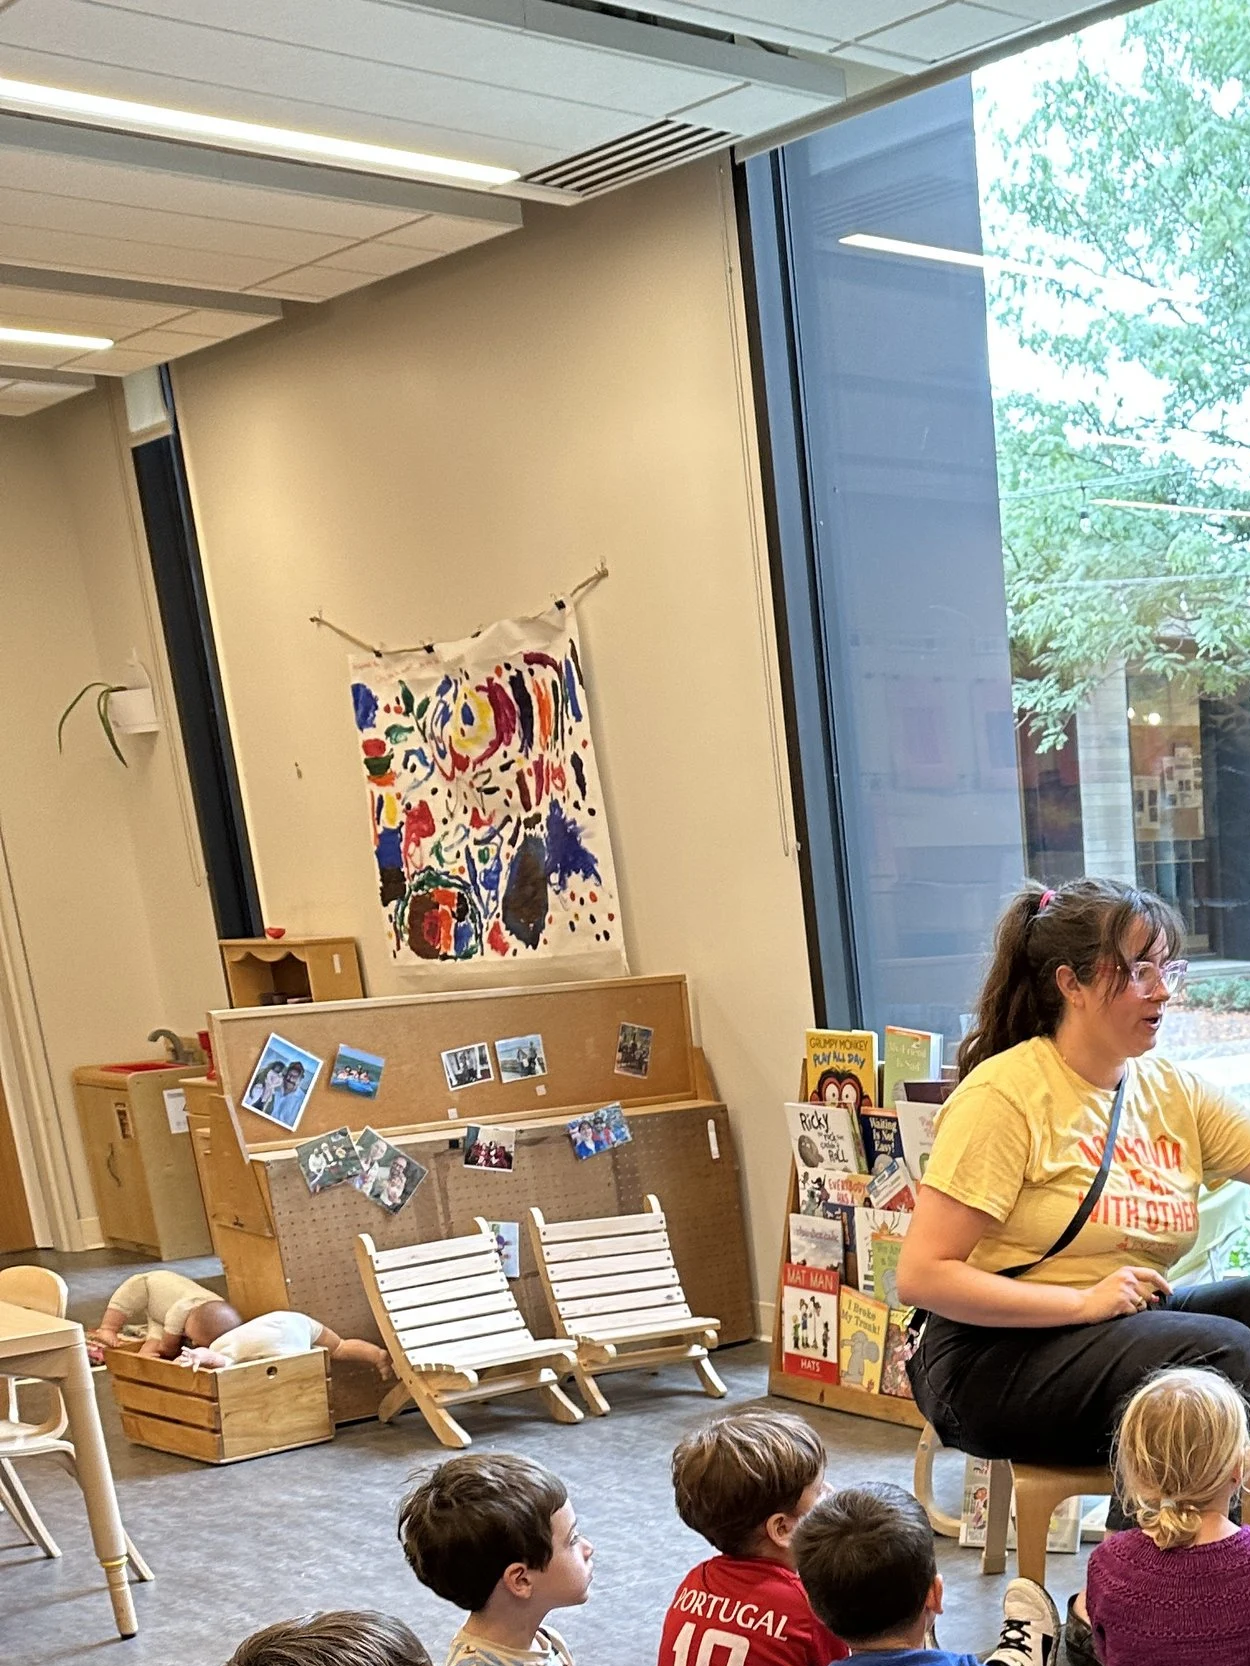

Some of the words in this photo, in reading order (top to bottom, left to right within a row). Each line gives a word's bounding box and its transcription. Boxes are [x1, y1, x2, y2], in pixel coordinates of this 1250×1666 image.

[809, 1037, 839, 1049] GRUMPY
[840, 1038, 868, 1051] MONKEY
[812, 1051, 831, 1067] PLAY
[833, 1050, 846, 1062] ALL
[848, 1053, 866, 1069] DAY
[800, 1110, 829, 1132] Ricky
[869, 1117, 897, 1132] Waiting
[873, 1129, 881, 1140] Is
[882, 1130, 895, 1142] Not
[828, 1178, 867, 1192] EVERYBODY
[787, 1268, 807, 1284] MAT
[809, 1271, 834, 1291] MAN
[847, 1300, 852, 1308] I
[853, 1301, 876, 1321] Broke
[841, 1310, 852, 1324] My
[853, 1316, 880, 1335] Trunk!
[800, 1359, 820, 1372] HATS
[673, 1587, 788, 1641] PORTUGAL
